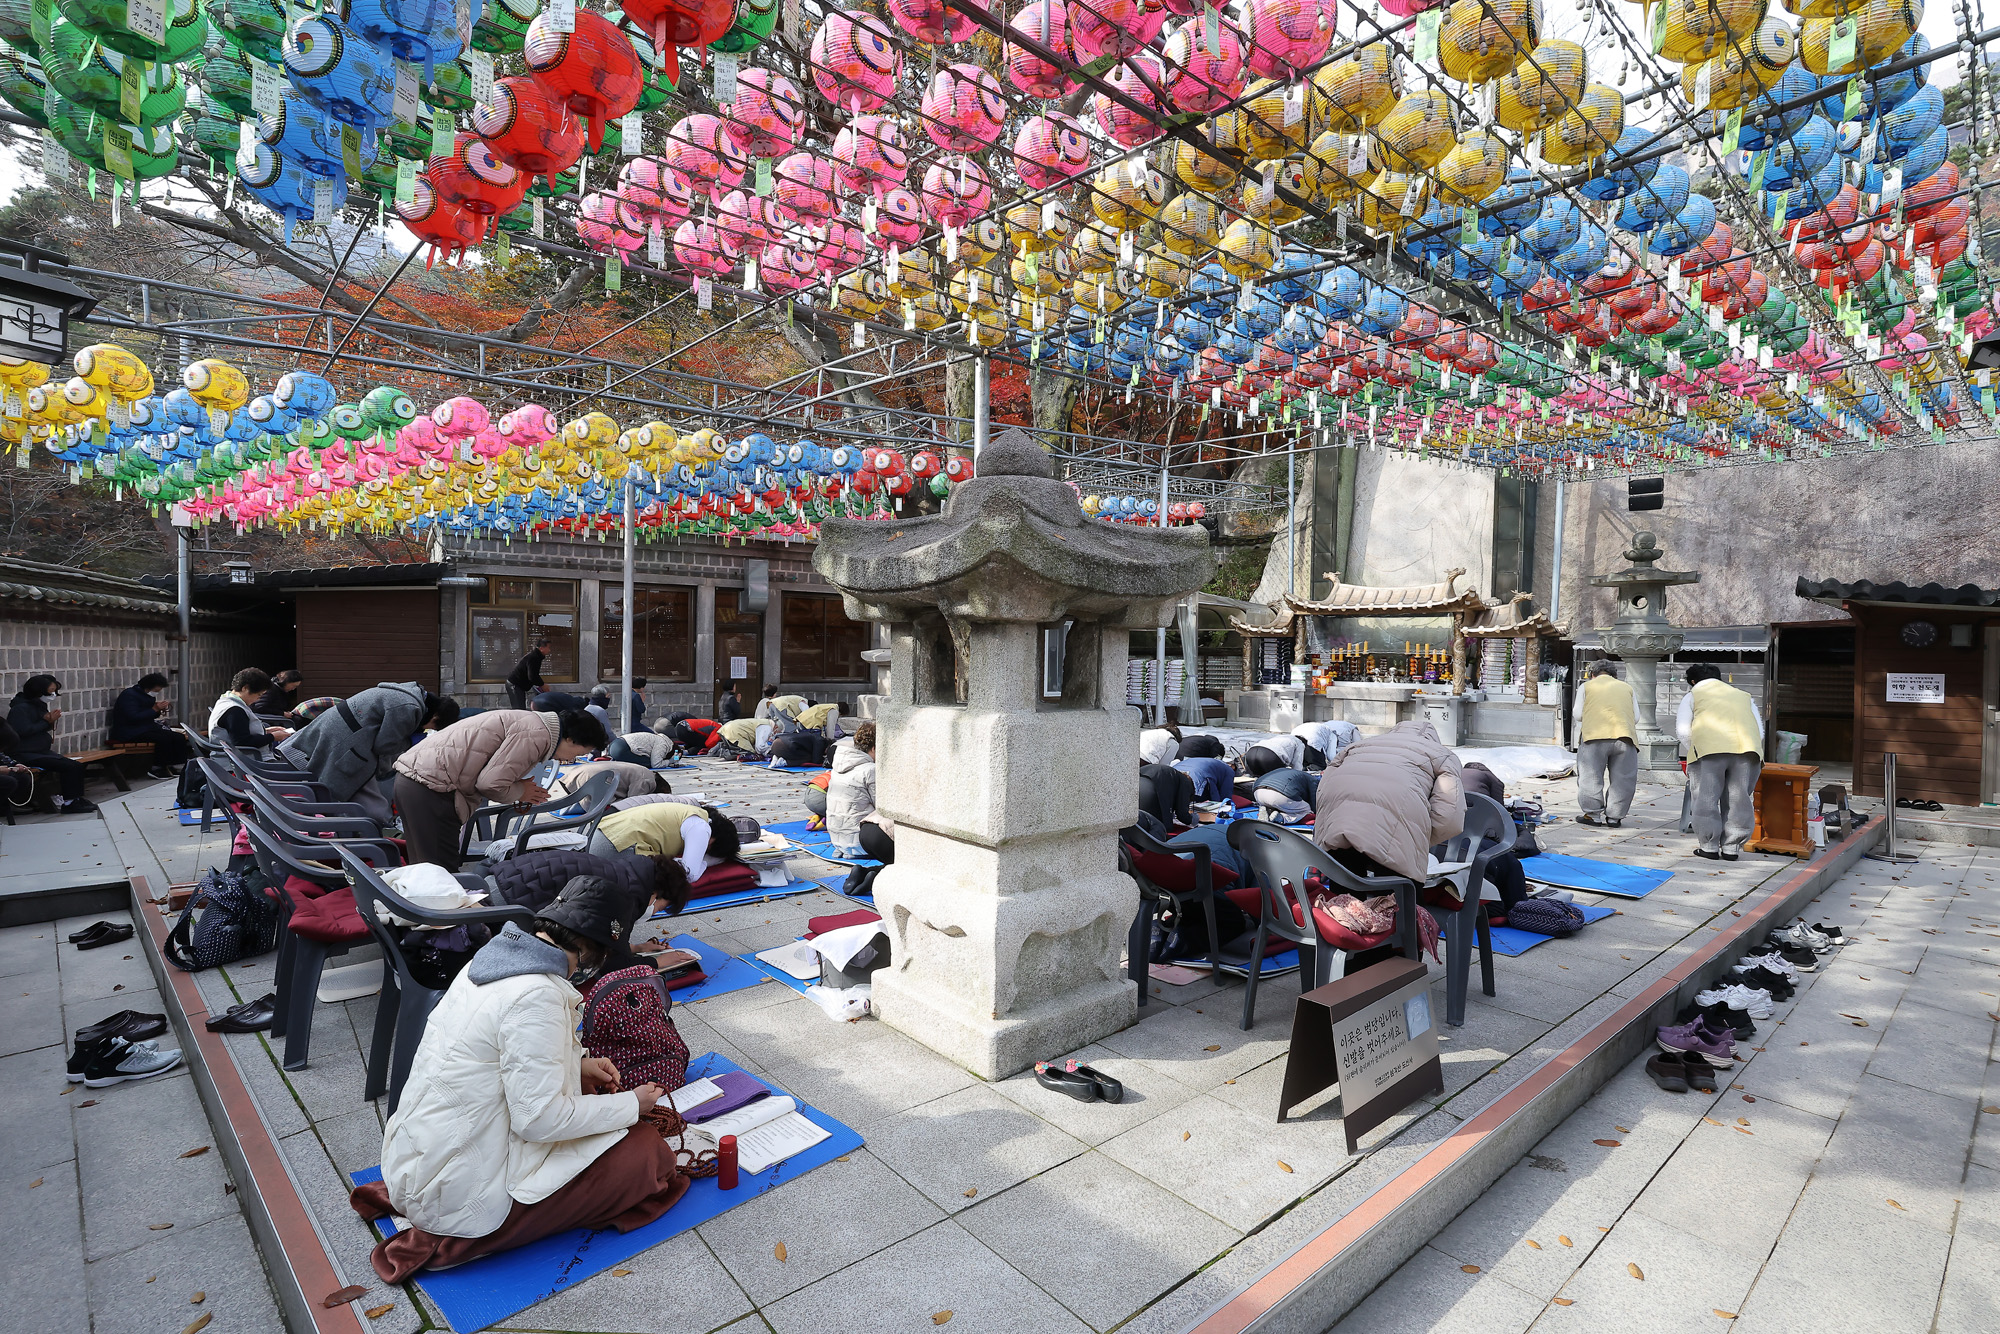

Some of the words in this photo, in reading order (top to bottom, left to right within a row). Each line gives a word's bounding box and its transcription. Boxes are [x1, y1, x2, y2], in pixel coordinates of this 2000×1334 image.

[1340, 1027, 1363, 1049] 이곳은
[1364, 1006, 1402, 1036] 법당입니다.
[1343, 1046, 1365, 1069] 신발을
[1366, 1025, 1404, 1055] 벗어주세요.
